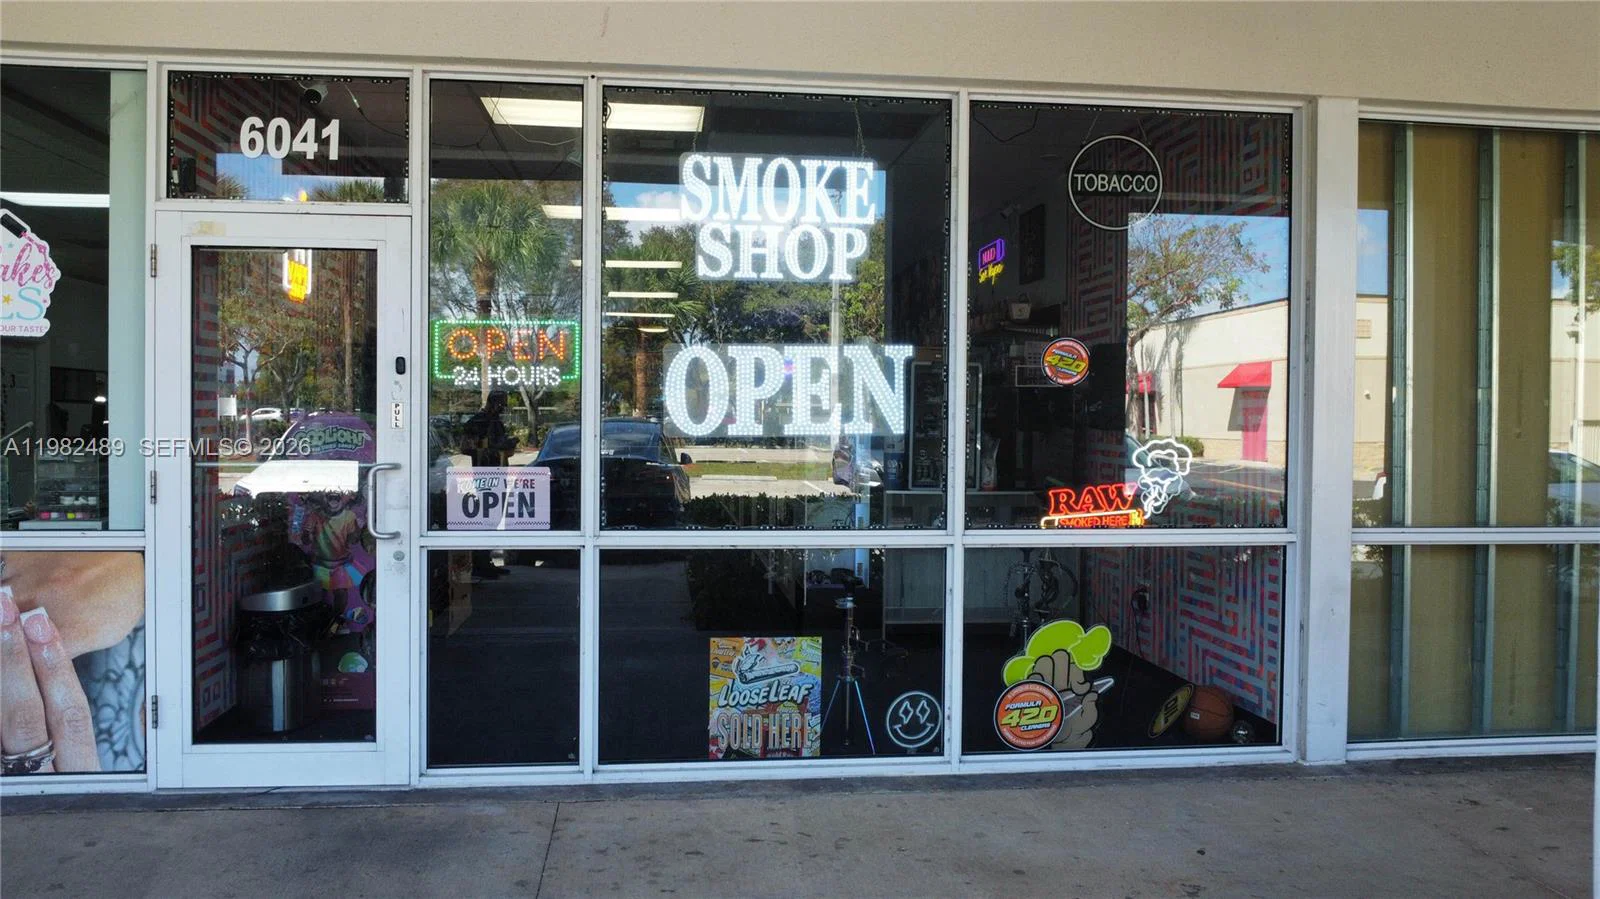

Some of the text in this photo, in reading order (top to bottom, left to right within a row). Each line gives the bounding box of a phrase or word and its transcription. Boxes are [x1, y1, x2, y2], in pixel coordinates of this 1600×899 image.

[239, 116, 341, 161] 6041
[679, 154, 877, 226] SMOKE
[1073, 173, 1158, 193] TOBACCO
[696, 223, 869, 281] SHOP
[448, 328, 566, 361] OPEN
[453, 366, 562, 386] 24 HOURS
[1046, 354, 1087, 374] 420
[664, 344, 914, 437] OPEN
[393, 403, 401, 428] PULL
[457, 477, 536, 493] OME IN WE'RE
[461, 491, 536, 519] OPEN
[1048, 481, 1139, 517] RAW
[1059, 515, 1129, 527] SMOKED HERE
[1000, 704, 1059, 728] 420
[1004, 699, 1043, 711] FORMULA
[716, 711, 813, 751] SOLD HERE
